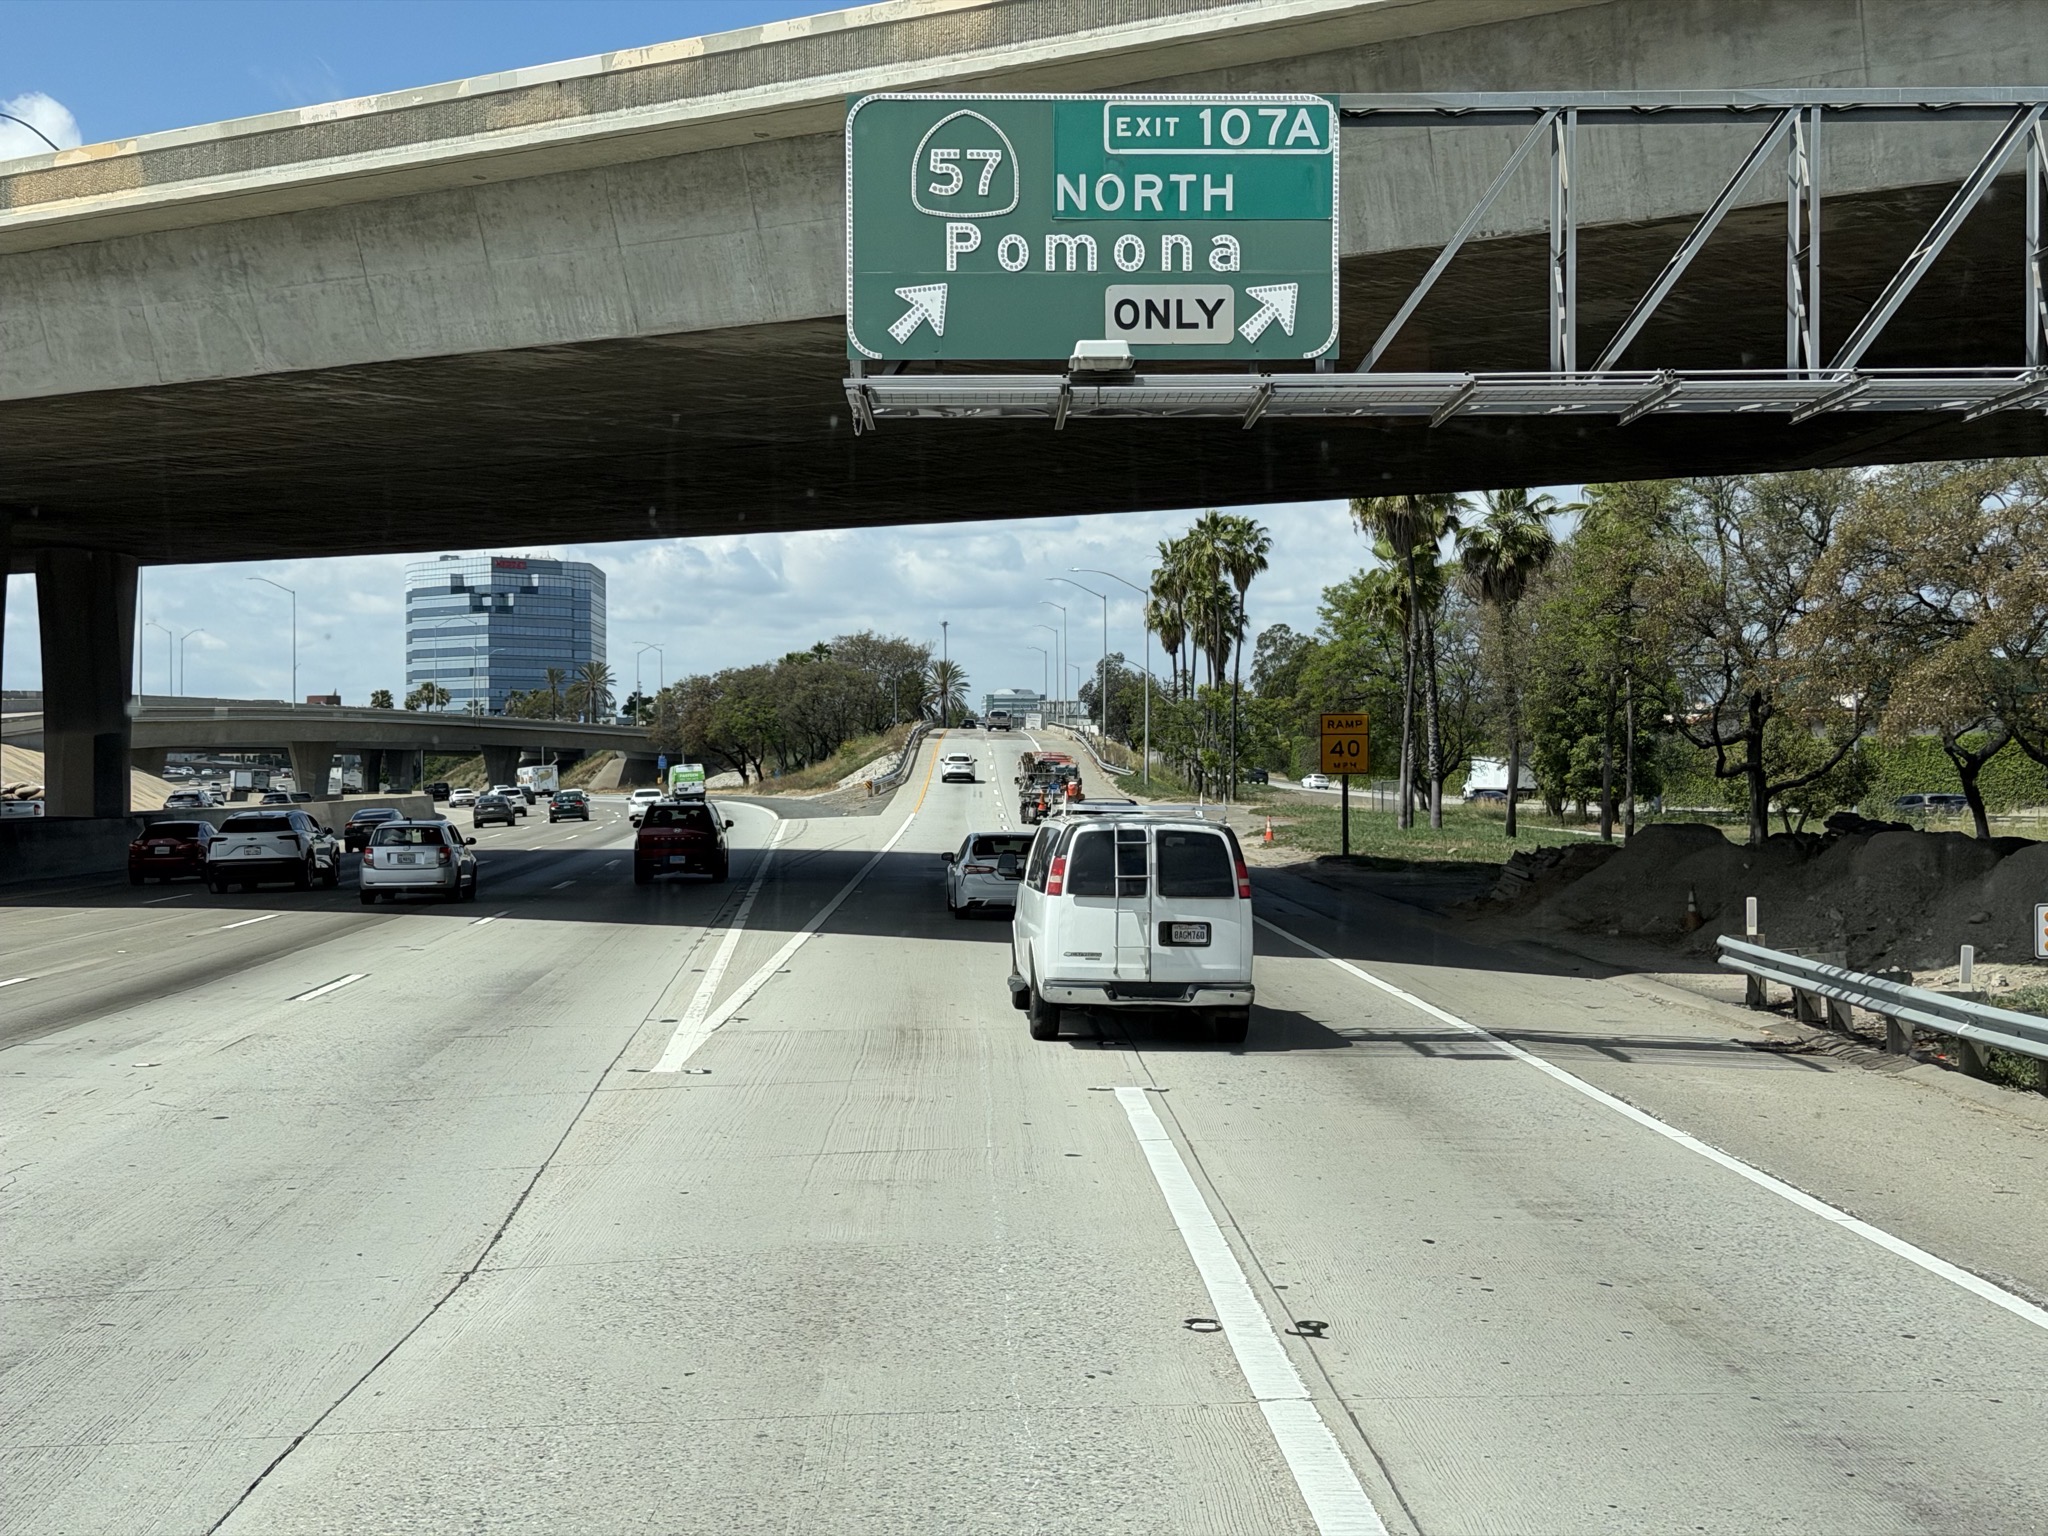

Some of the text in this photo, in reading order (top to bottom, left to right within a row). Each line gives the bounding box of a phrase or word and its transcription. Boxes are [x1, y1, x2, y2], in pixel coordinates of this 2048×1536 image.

[1116, 108, 1321, 146] EXIT 107A
[928, 148, 1002, 196] 57
[1056, 173, 1234, 211] NORTH
[945, 222, 1241, 272] Pomona
[1113, 298, 1225, 330] ONLY
[1327, 720, 1363, 729] RAMP
[1330, 739, 1360, 757] 40
